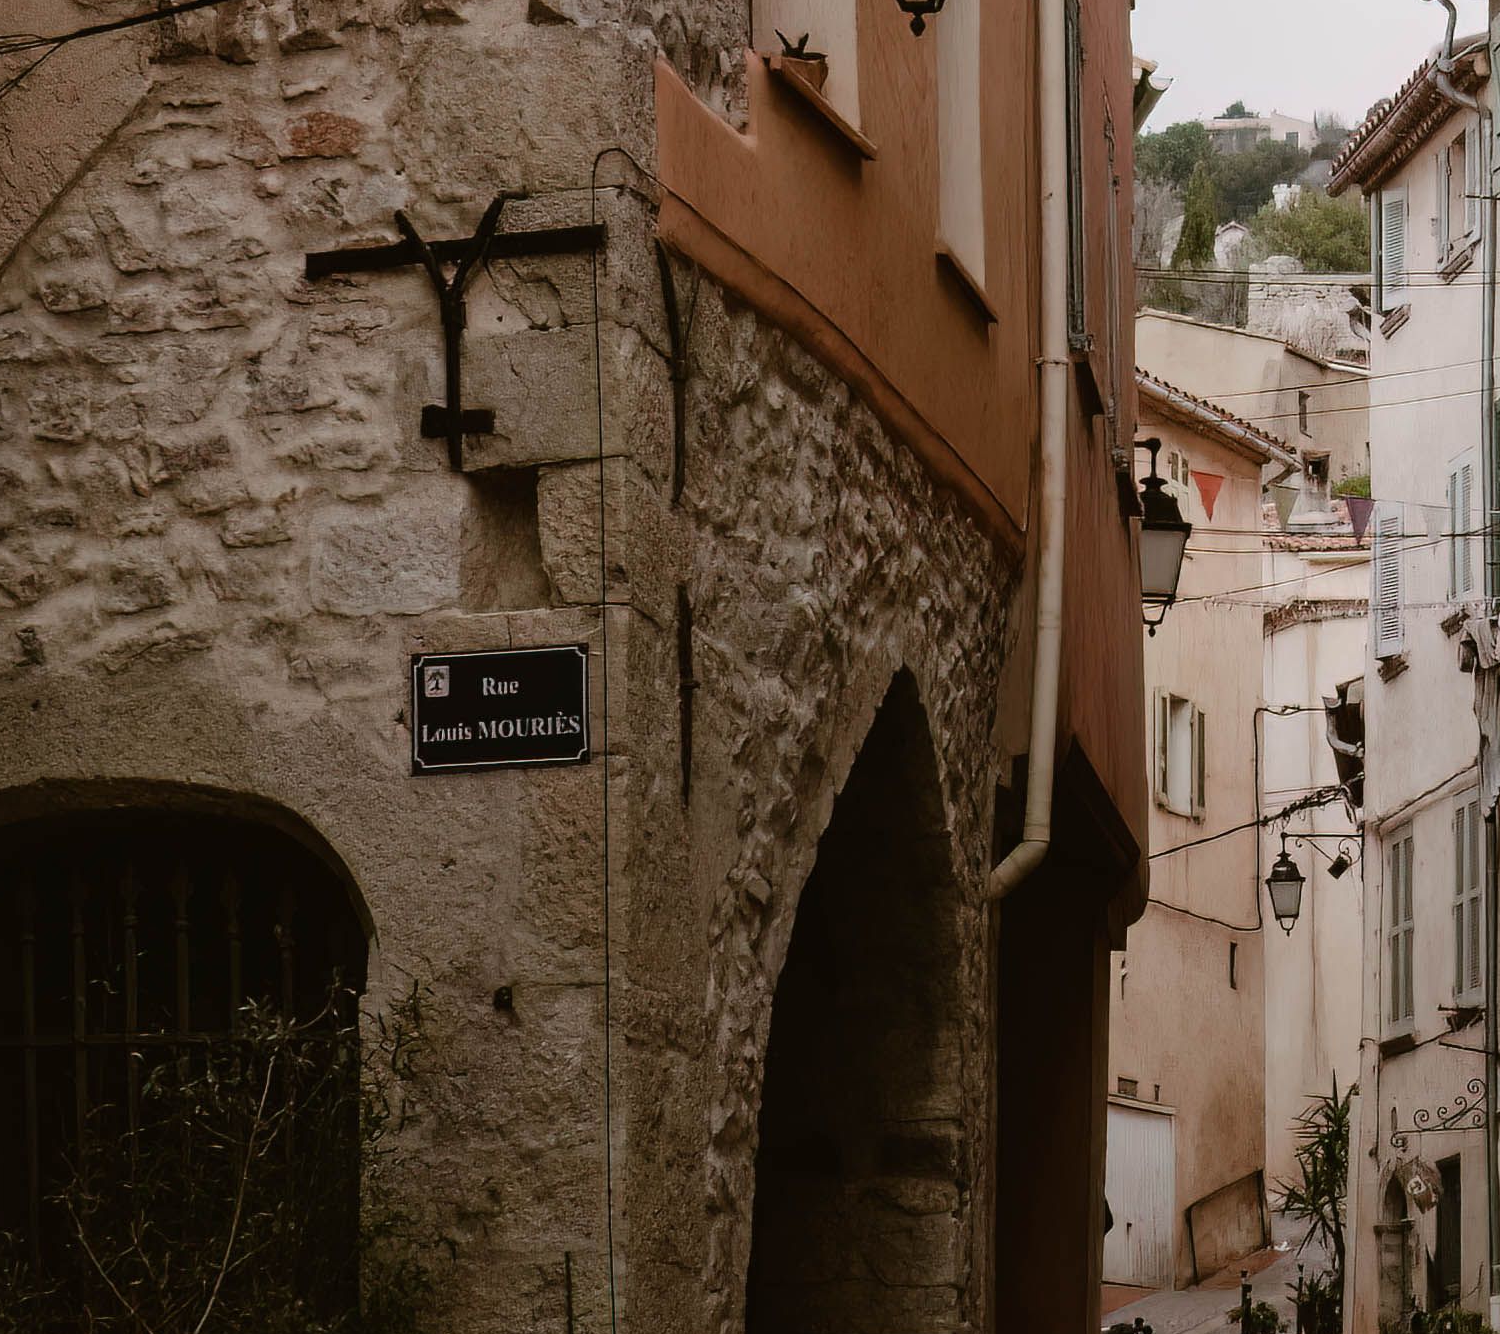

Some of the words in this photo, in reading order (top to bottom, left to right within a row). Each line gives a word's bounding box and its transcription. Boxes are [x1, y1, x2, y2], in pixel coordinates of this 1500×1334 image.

[481, 677, 520, 696] Rue
[420, 723, 473, 744] Louis
[477, 709, 581, 739] MOURIÈS
